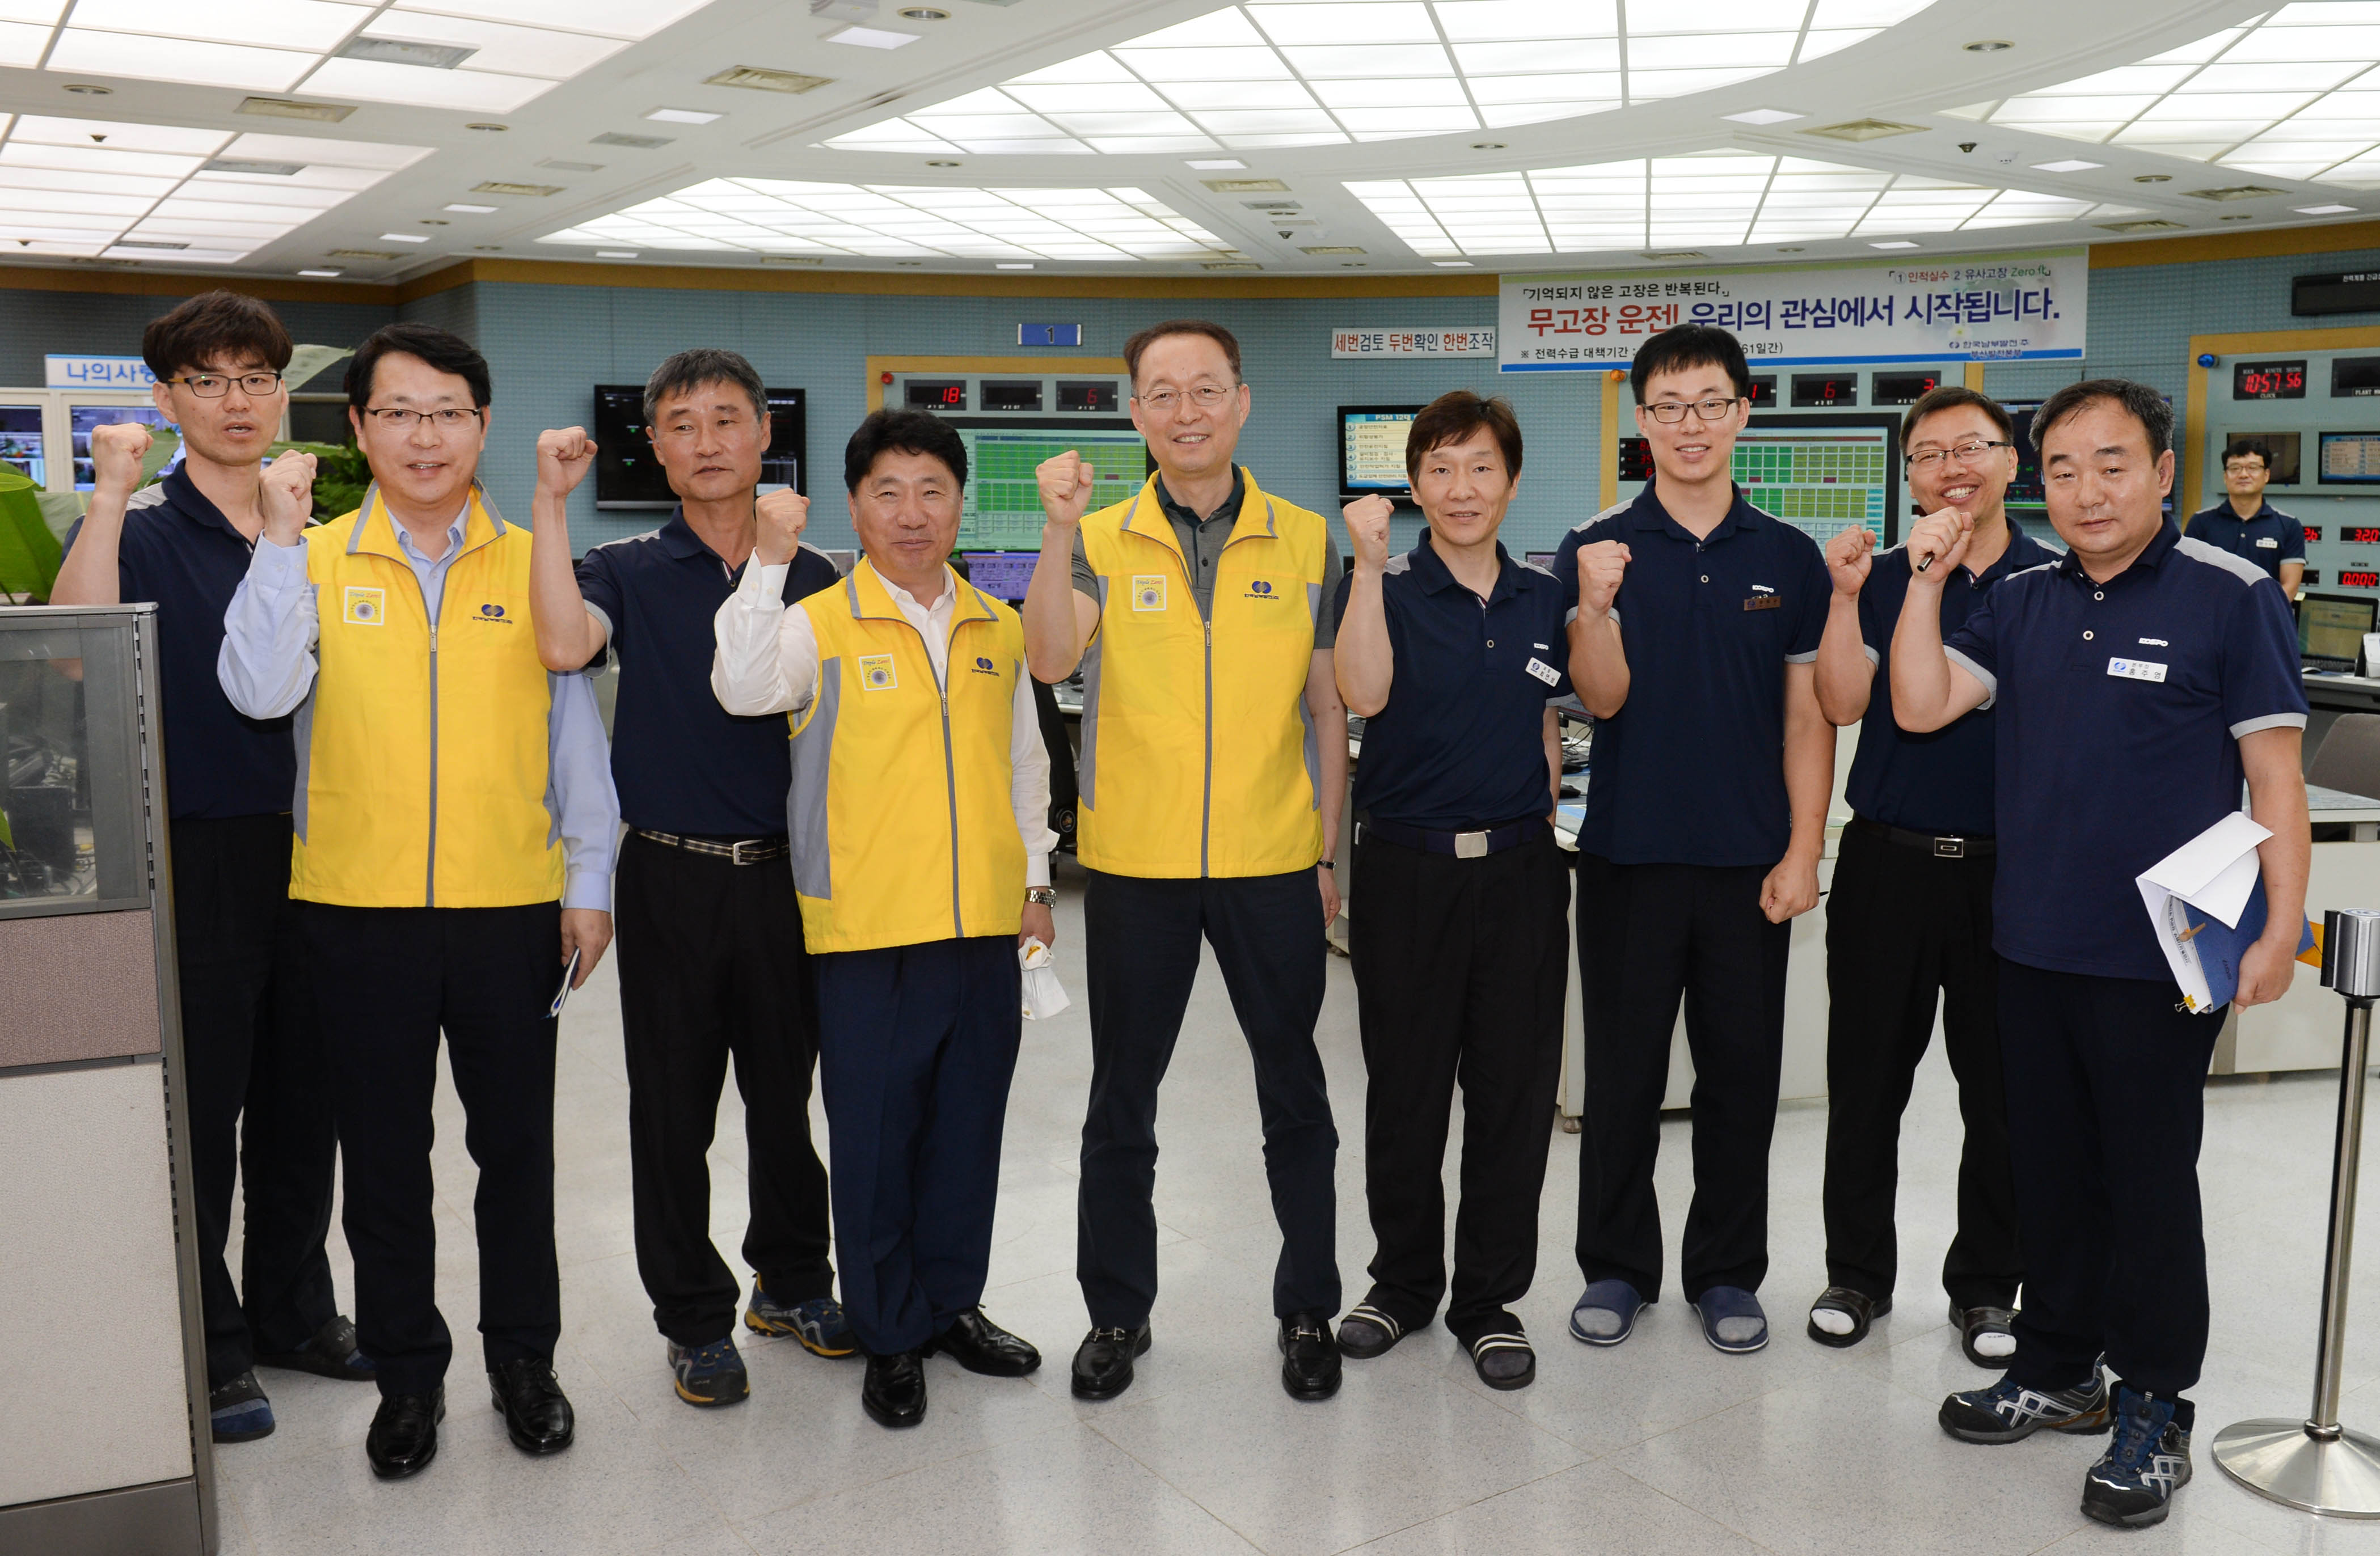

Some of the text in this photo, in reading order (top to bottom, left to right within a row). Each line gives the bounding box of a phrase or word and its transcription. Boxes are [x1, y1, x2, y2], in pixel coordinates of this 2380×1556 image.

[1965, 268, 2007, 281] 유사고장
[1587, 285, 1614, 299] 않은
[1619, 284, 1660, 298] 고장은
[1527, 306, 1610, 337] 무고장
[1688, 300, 1771, 331] 우리의
[1780, 295, 1894, 329] 관심에서
[1904, 287, 2060, 325] 시작됩니다.
[1046, 325, 1054, 343] 1
[1334, 332, 1493, 352] 세번검토 두번확인 한번조작
[1535, 347, 1580, 360] 전력수급
[1584, 346, 1628, 358] 대책기간
[942, 387, 961, 403] 18
